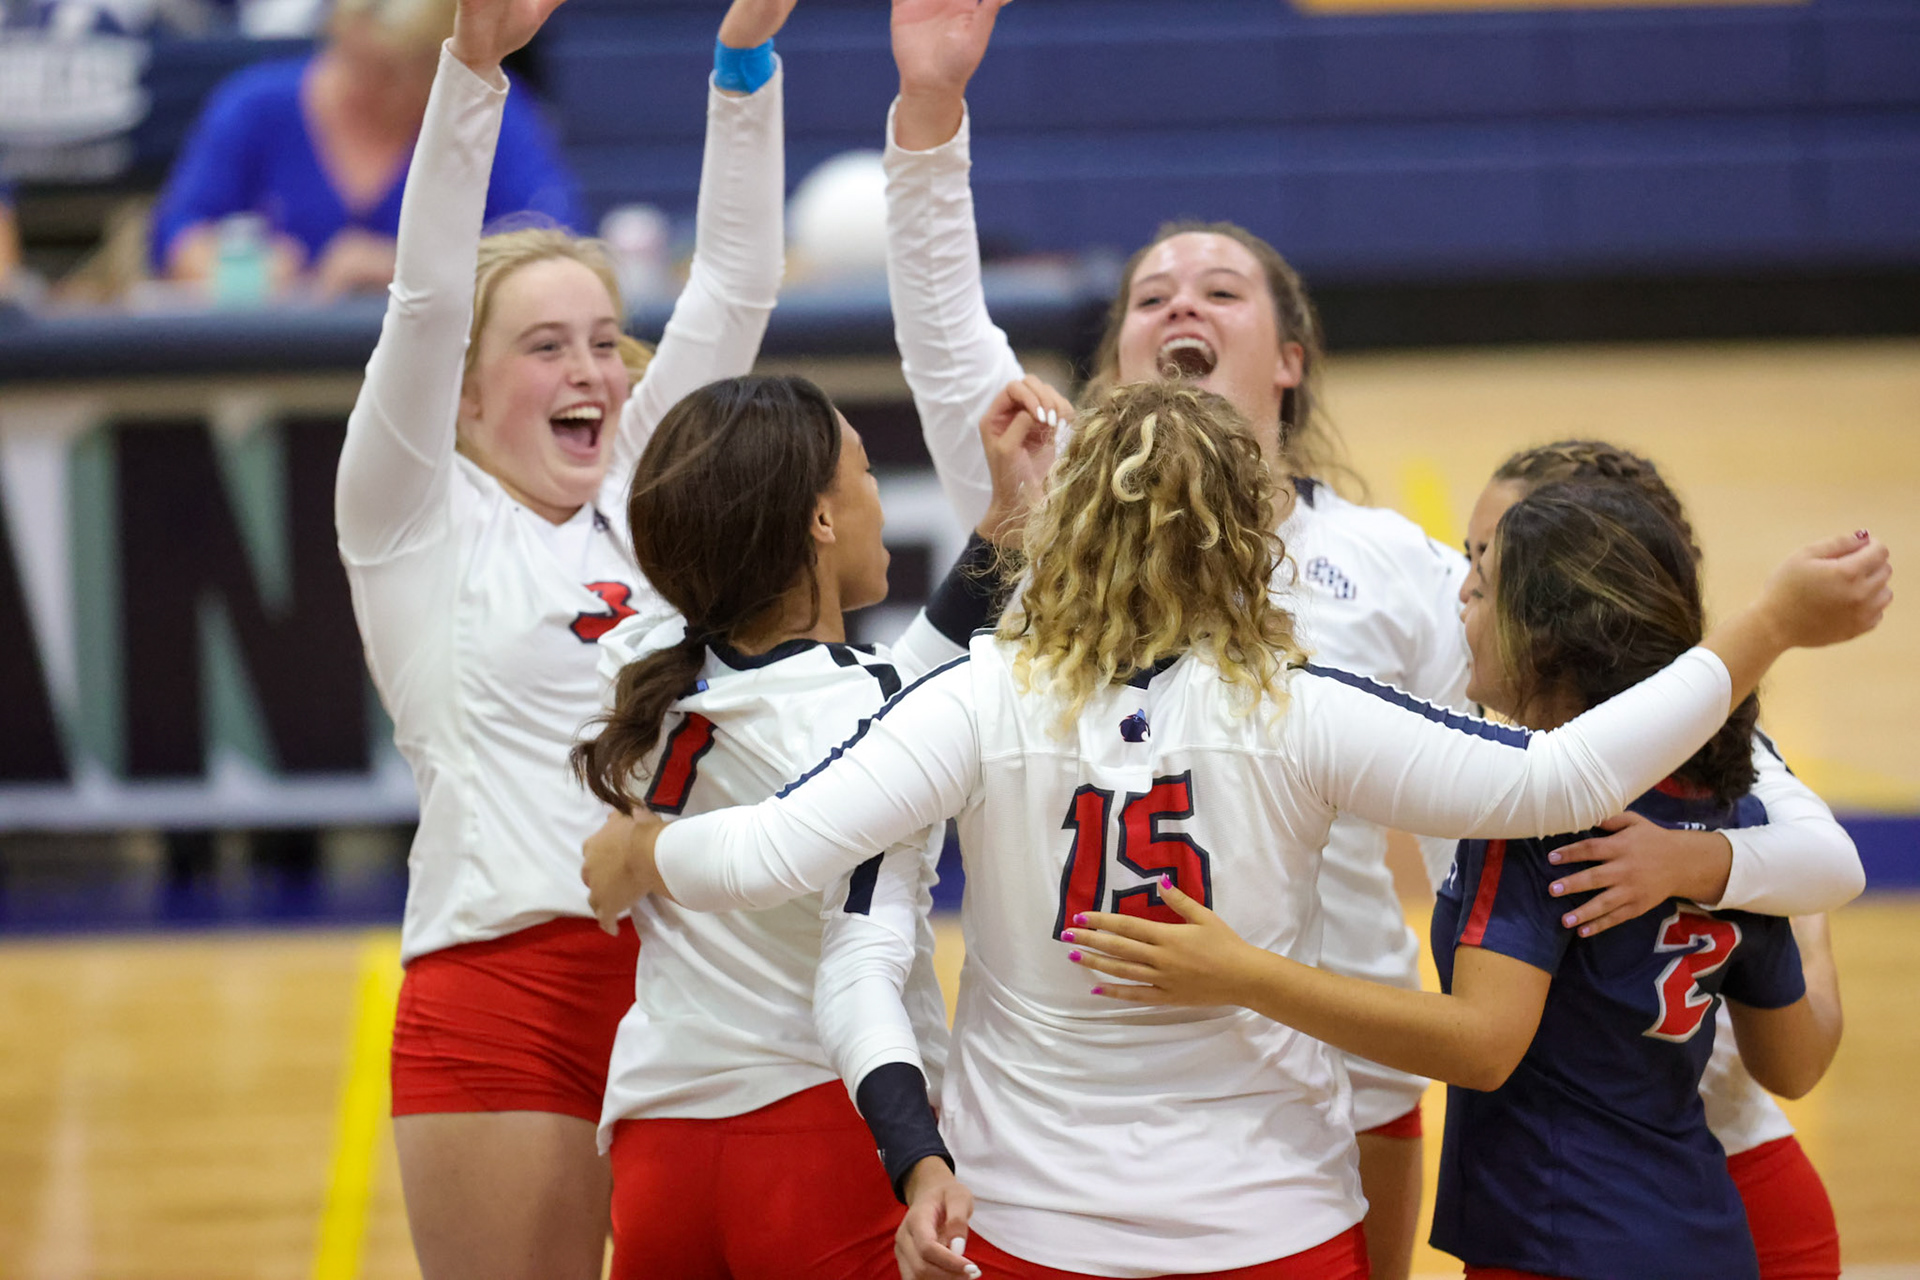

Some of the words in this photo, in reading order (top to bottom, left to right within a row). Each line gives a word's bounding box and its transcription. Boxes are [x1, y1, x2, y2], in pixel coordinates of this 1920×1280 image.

[568, 580, 640, 644] 3
[1052, 769, 1214, 941] 15
[1641, 902, 1743, 1044] 2
